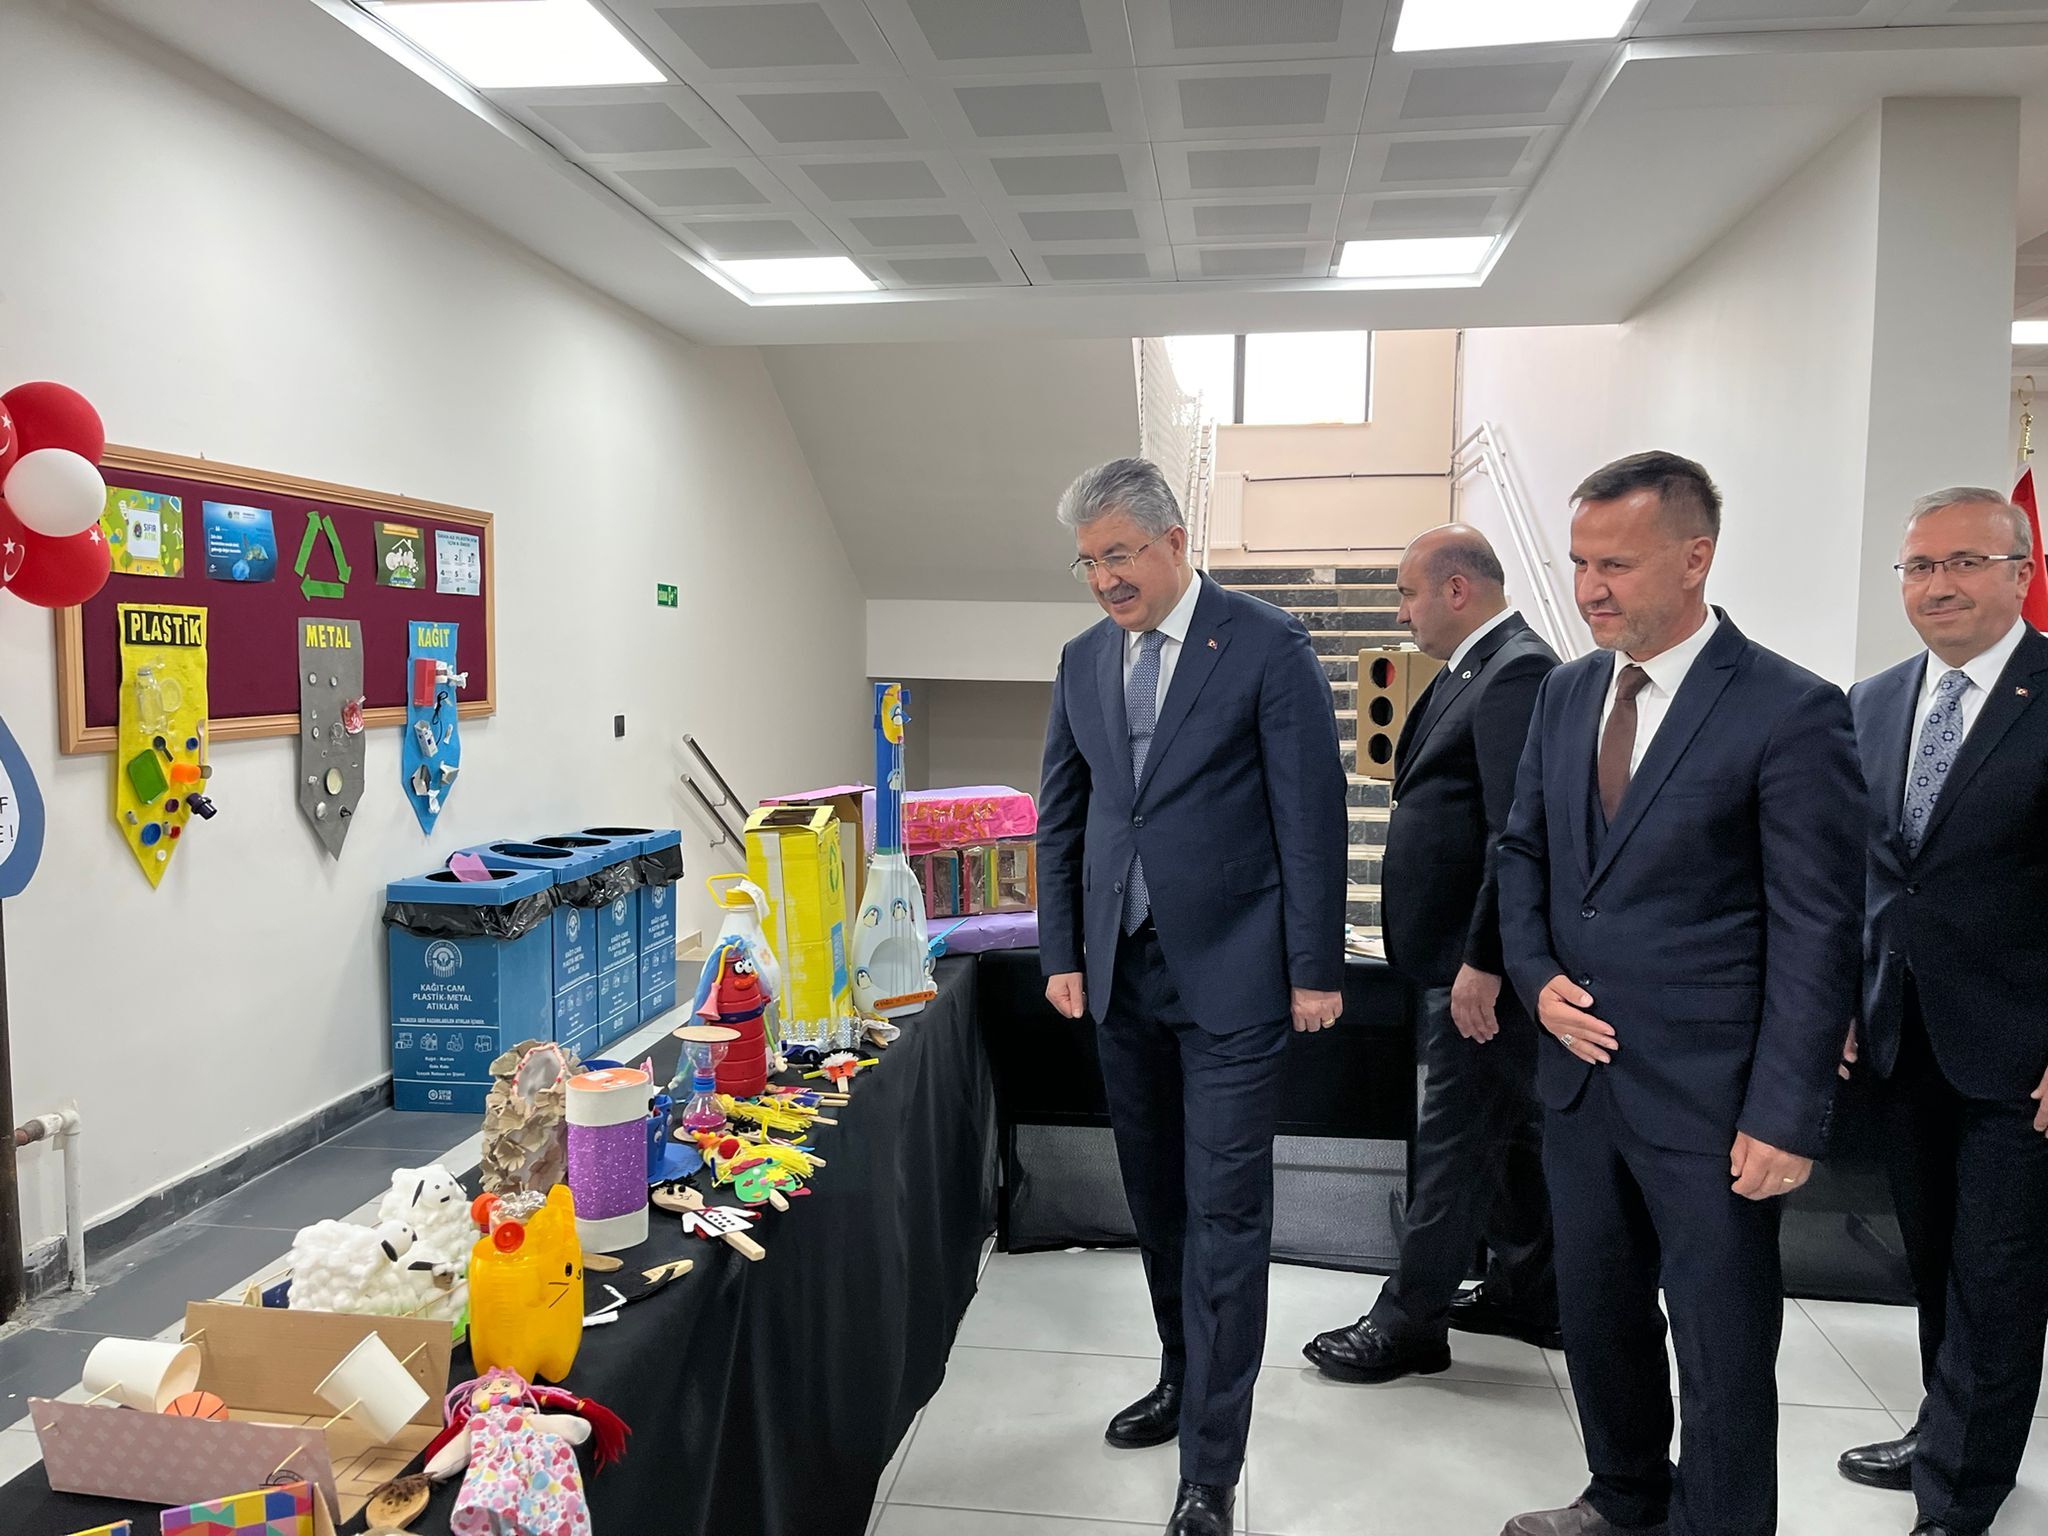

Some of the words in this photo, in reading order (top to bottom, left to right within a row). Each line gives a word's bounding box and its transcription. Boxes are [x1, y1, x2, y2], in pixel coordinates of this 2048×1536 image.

[131, 609, 201, 645] PLASTİK
[416, 622, 451, 648] KAĞIT
[305, 624, 352, 648] METAL
[420, 982, 466, 993] KAĞIT-CAM
[412, 992, 473, 1002] PLASTİK-METAL
[426, 1002, 459, 1011] ATIKLAR
